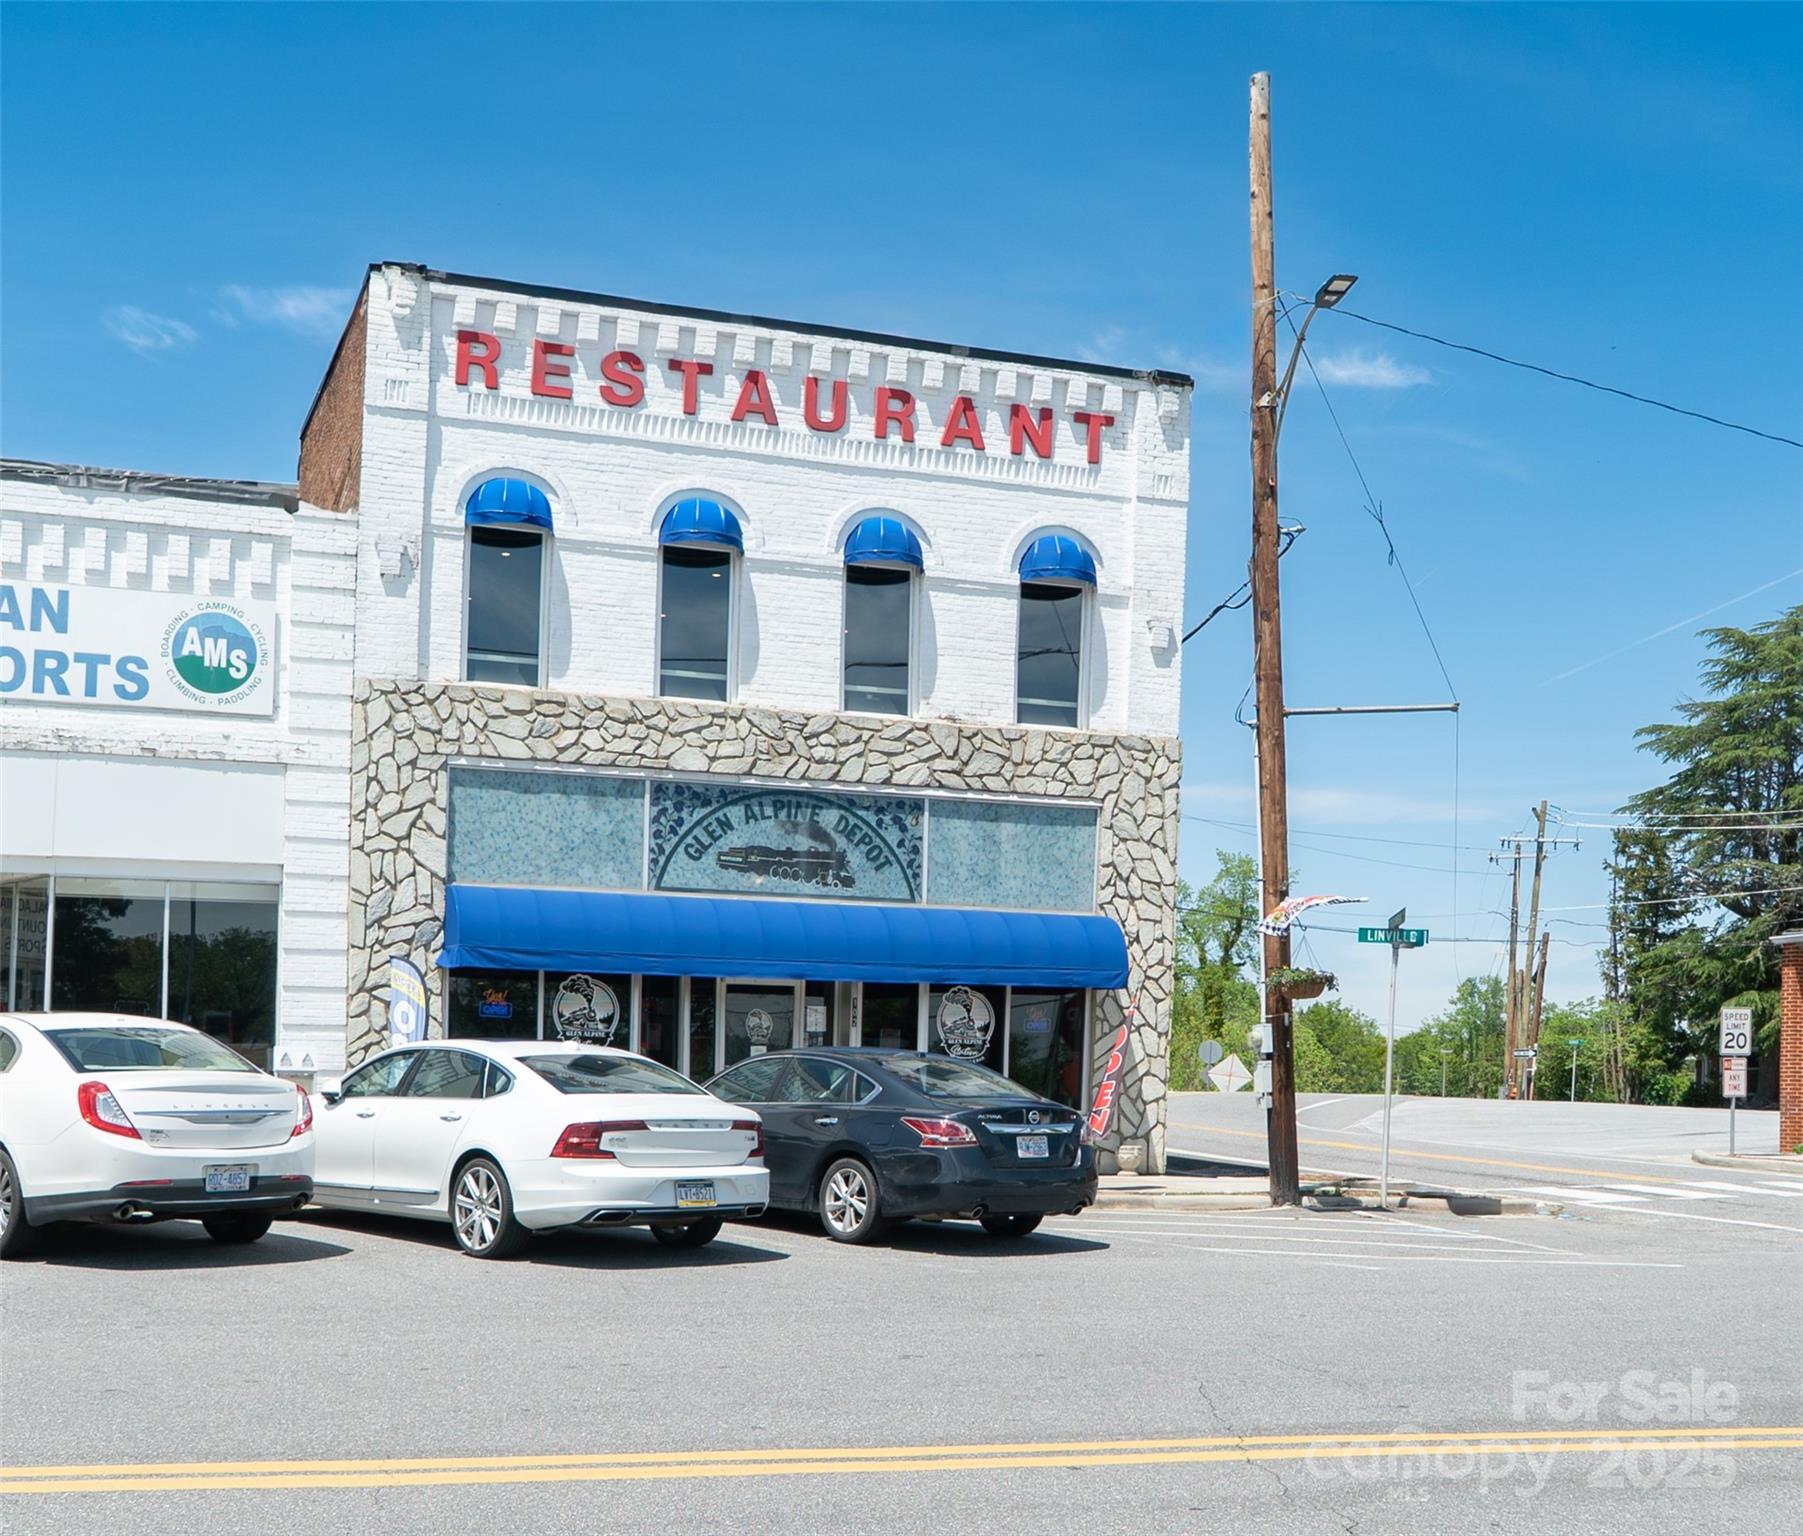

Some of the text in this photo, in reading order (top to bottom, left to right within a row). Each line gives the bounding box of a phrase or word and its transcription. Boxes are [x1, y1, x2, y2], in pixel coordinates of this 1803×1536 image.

[455, 331, 1114, 464] RESTAURANT
[160, 602, 269, 666] BOARDING CAMPING CYCLING
[181, 627, 248, 680] AMS
[166, 669, 262, 706] CLIMBING PADDLING
[684, 800, 893, 872] GLEN ALPINE DEPOT
[1724, 1012, 1749, 1021] SPEED
[1726, 1022, 1746, 1031] LIMIT
[1724, 1032, 1747, 1049] 20
